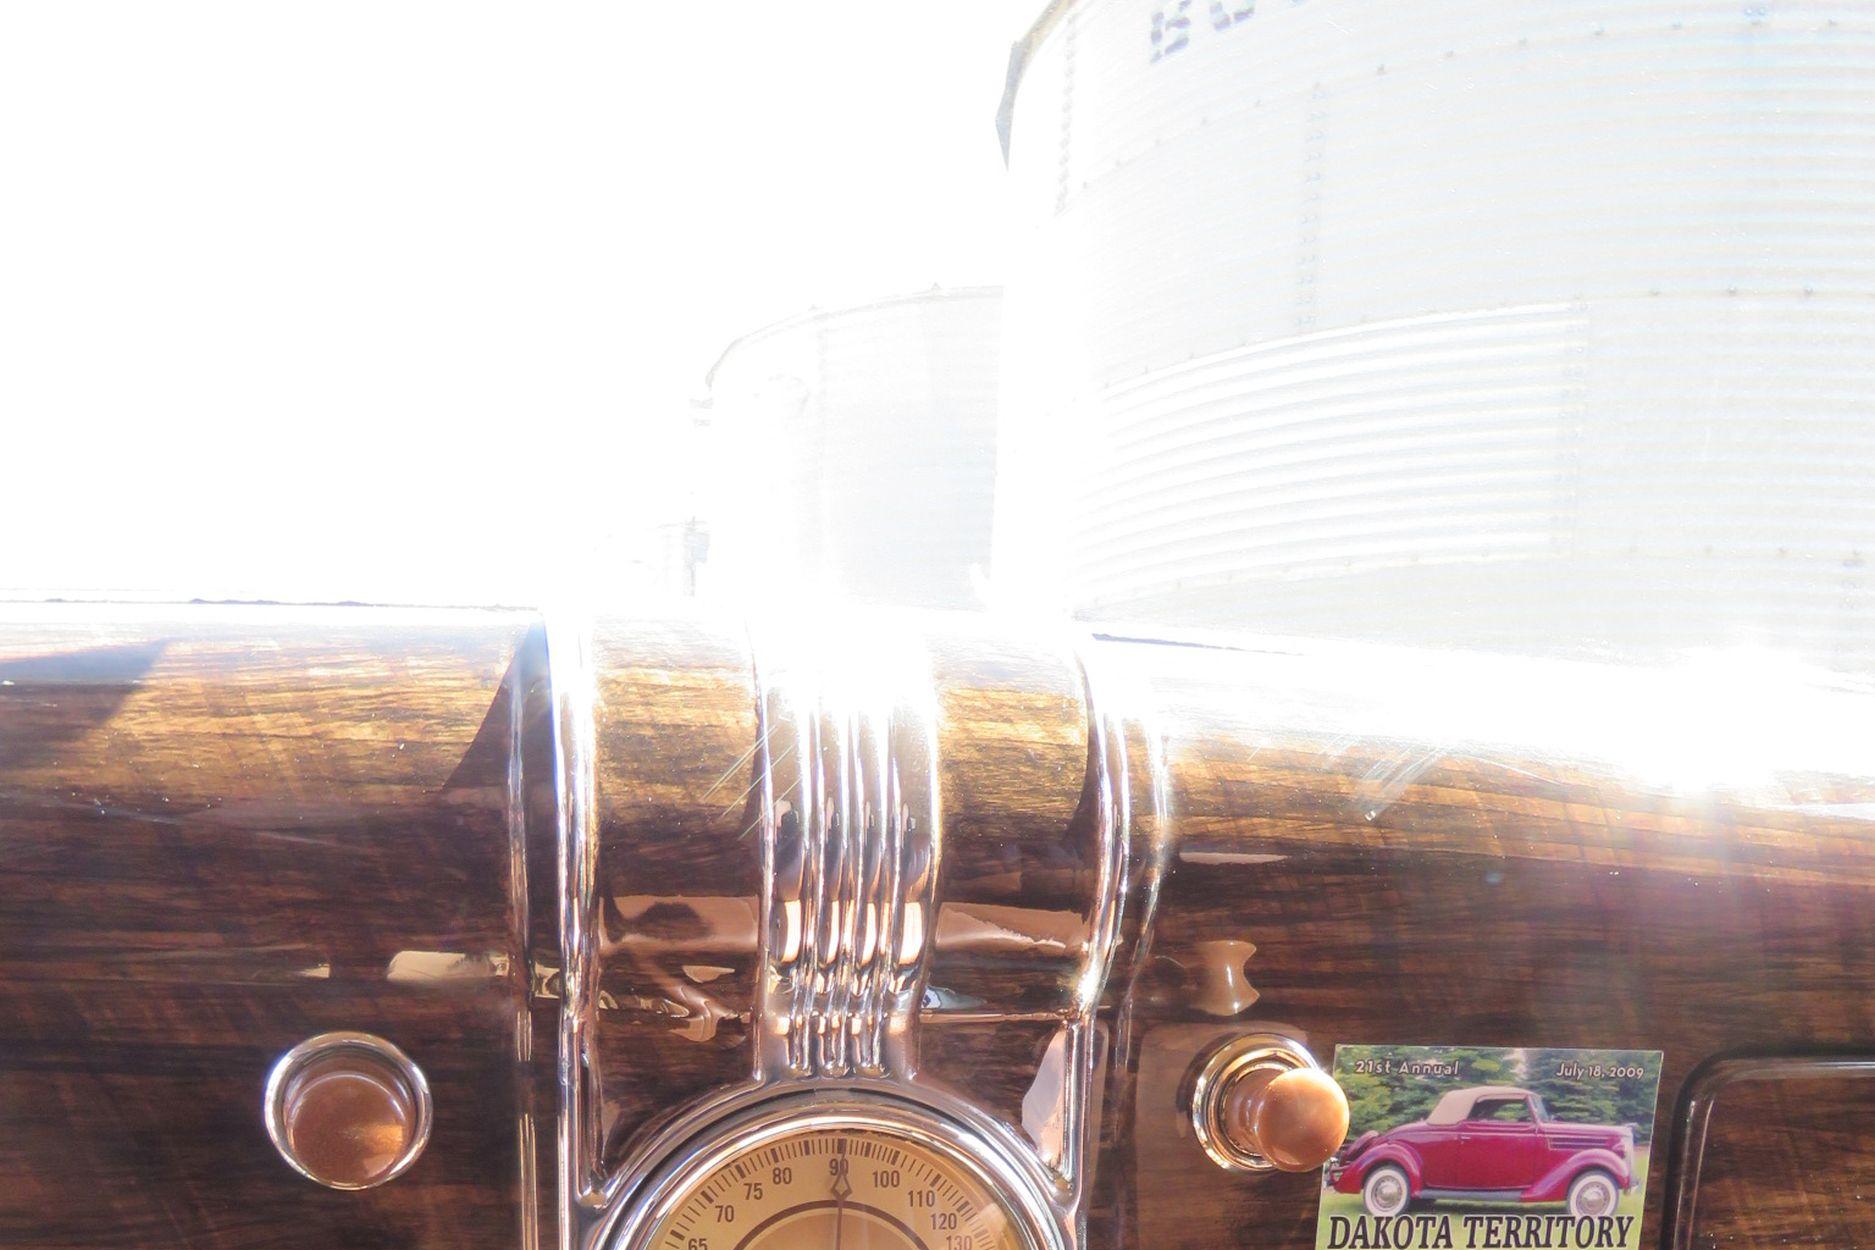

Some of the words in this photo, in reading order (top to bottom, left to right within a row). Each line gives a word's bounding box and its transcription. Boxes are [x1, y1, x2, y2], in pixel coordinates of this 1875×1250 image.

[1355, 1060, 1391, 1075] 21st
[1398, 1060, 1460, 1075] Annual
[1556, 1062, 1585, 1081] July
[1588, 1065, 1605, 1078] 18,
[1609, 1066, 1644, 1080] 2009
[772, 1168, 792, 1186] 80
[828, 1158, 849, 1177] 90
[872, 1171, 900, 1189] 100
[744, 1182, 763, 1201] 75
[907, 1189, 935, 1208] 110
[715, 1204, 735, 1223] 70
[930, 1213, 957, 1231] 120
[1327, 1216, 1453, 1250] DAKOTA
[1464, 1216, 1635, 1249] TERRITORY
